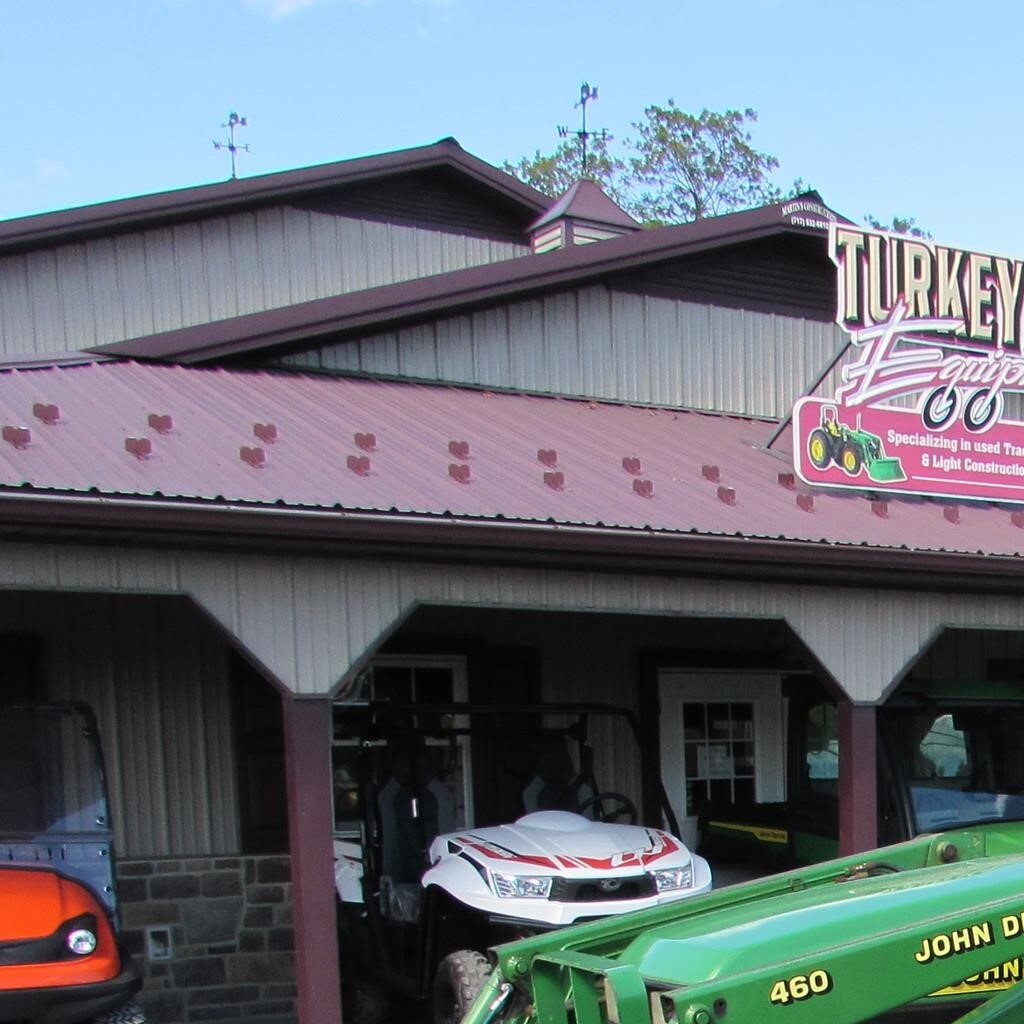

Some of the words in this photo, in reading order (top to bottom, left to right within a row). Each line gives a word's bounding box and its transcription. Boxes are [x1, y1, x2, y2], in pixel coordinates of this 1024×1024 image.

[887, 430, 958, 452] Specializing
[960, 438, 971, 451] in
[974, 441, 1000, 453] used
[921, 454, 929, 467] &
[932, 455, 961, 472] Light
[914, 920, 994, 963] JOHN
[769, 969, 833, 1005] 460
